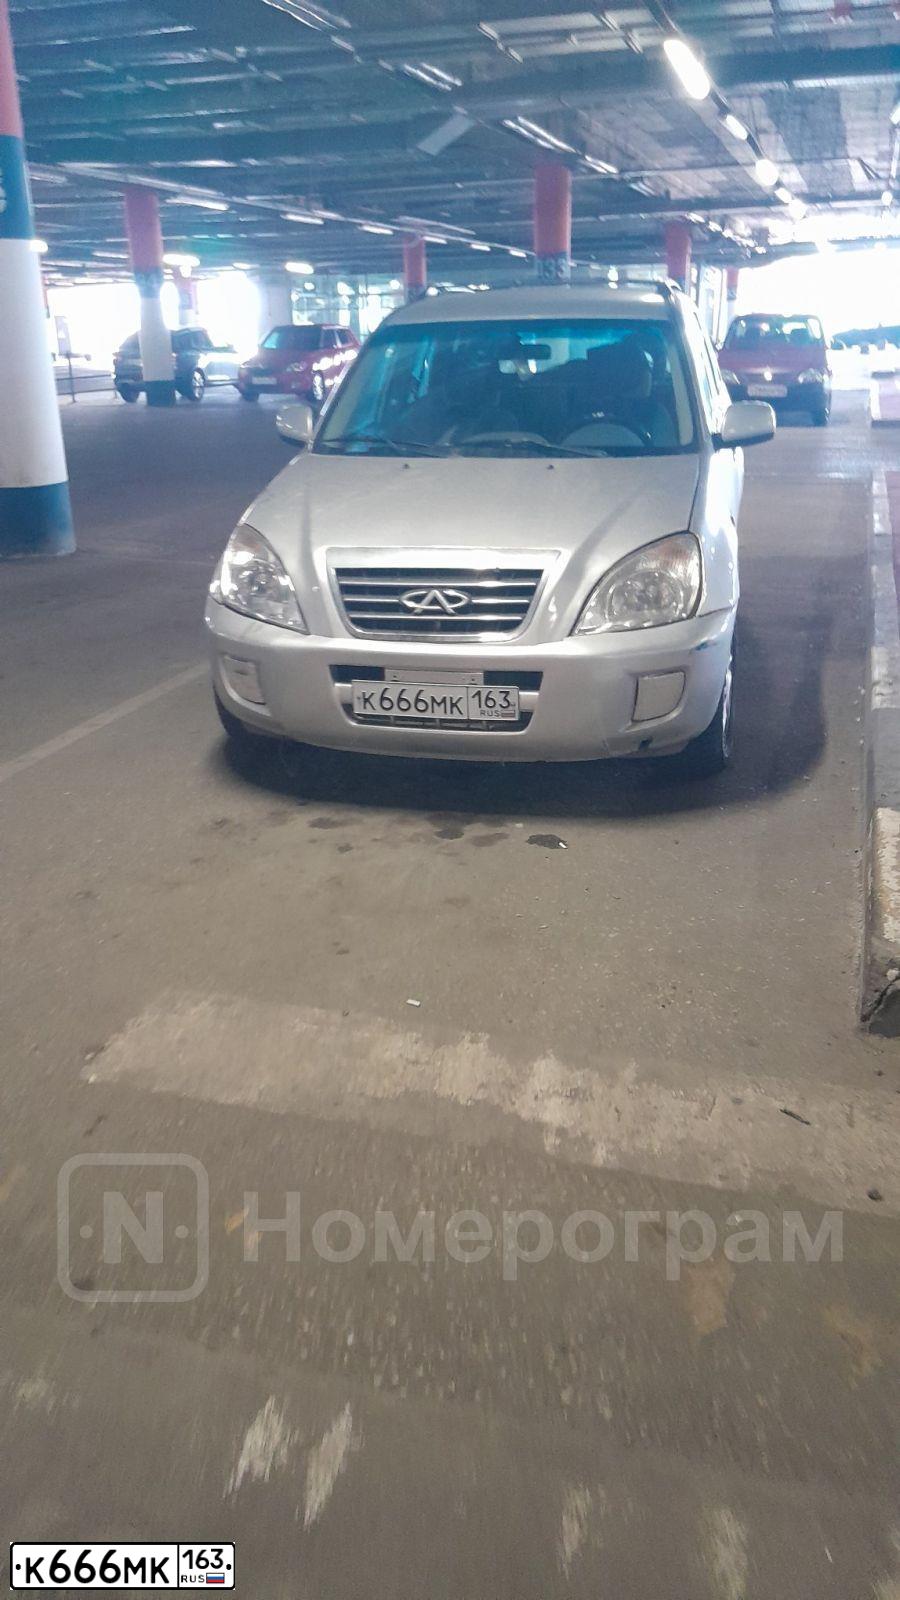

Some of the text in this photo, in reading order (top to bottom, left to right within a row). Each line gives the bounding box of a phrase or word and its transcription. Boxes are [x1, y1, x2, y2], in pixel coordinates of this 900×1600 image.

[361, 687, 511, 715] К666МК 163
[479, 709, 500, 718] RUS
